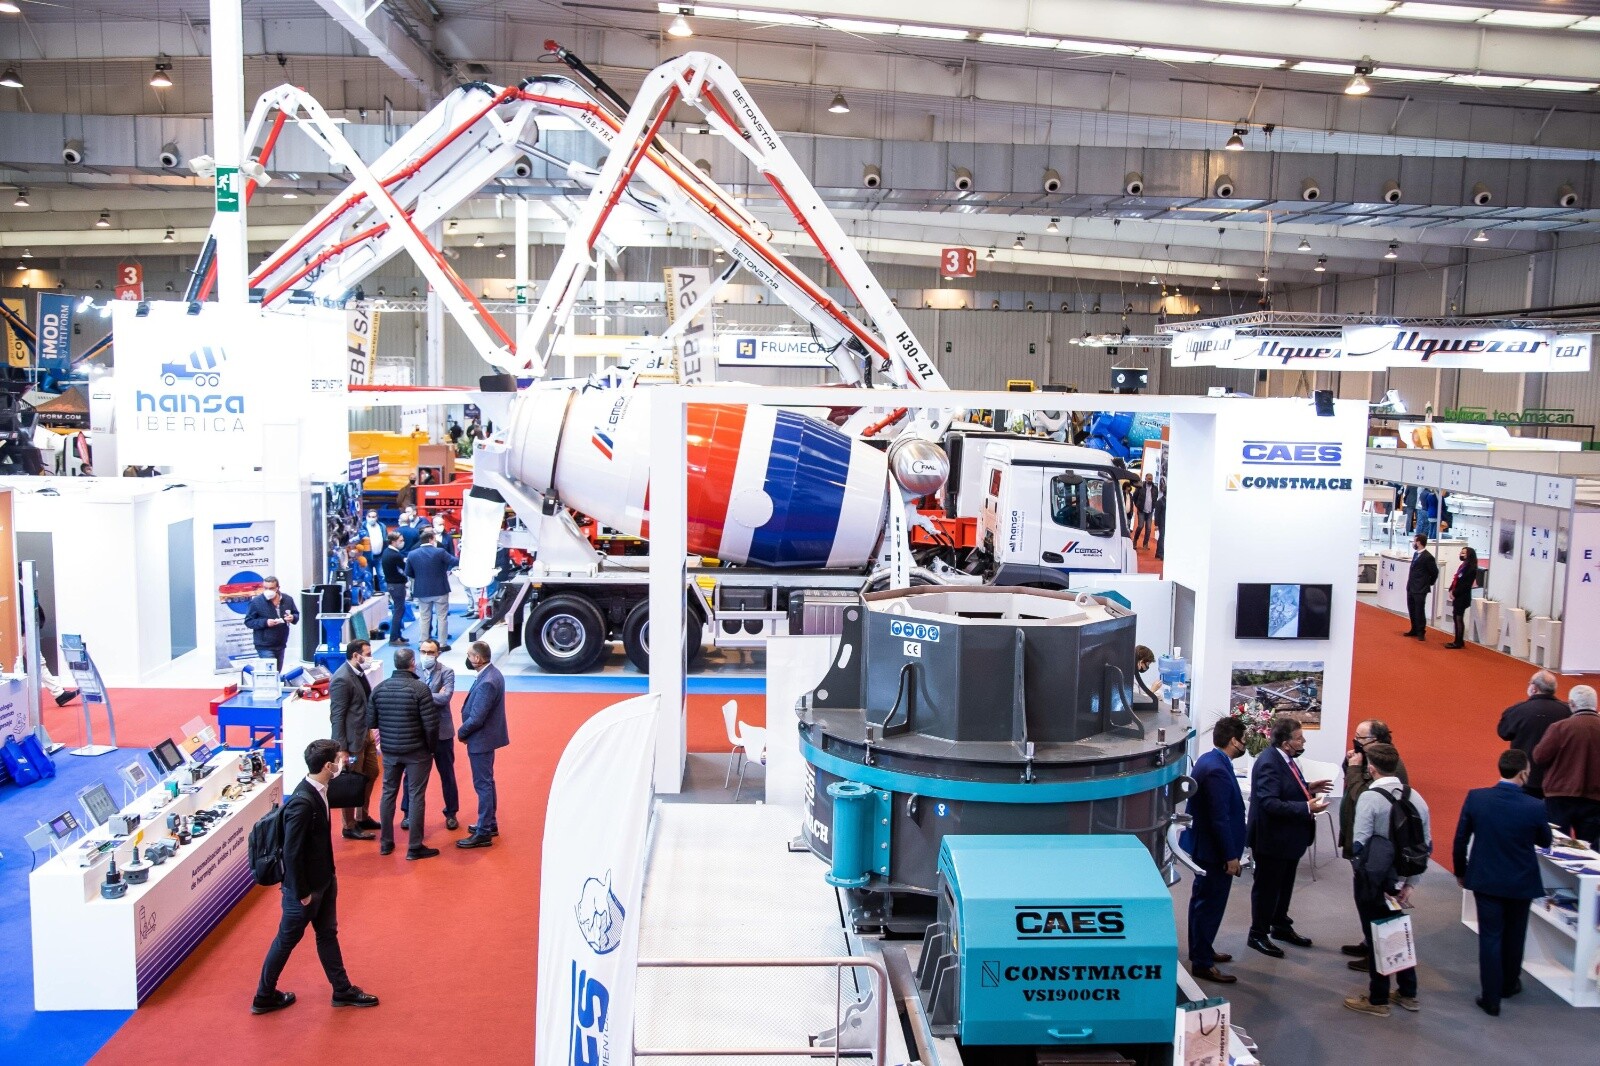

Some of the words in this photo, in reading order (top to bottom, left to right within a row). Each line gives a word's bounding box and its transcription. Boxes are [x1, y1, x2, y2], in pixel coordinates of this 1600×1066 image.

[733, 89, 776, 150] BETONSTAR
[732, 247, 779, 289] BETONSTAR
[946, 251, 959, 272] 3
[966, 252, 974, 273] 3
[124, 266, 138, 285] 3
[42, 313, 59, 360] iMOD
[348, 303, 369, 385] EBHSA
[761, 341, 826, 354] FRUMECA
[1348, 331, 1549, 362] Alquezar
[896, 331, 933, 380] H30-4Z
[1234, 341, 1341, 365] Alque
[1556, 344, 1586, 358] zar
[136, 390, 244, 413] hansa
[1492, 408, 1575, 426] tecymacan
[1242, 444, 1343, 462] CAES
[1242, 476, 1353, 490] CONSTMACH
[1009, 510, 1018, 541] hansa
[233, 535, 270, 545] hansa
[1016, 911, 1125, 934] CAES
[1004, 965, 1163, 982] CONSTMACH
[1022, 988, 1121, 1002] VSI900CR
[575, 969, 610, 1066] ES
